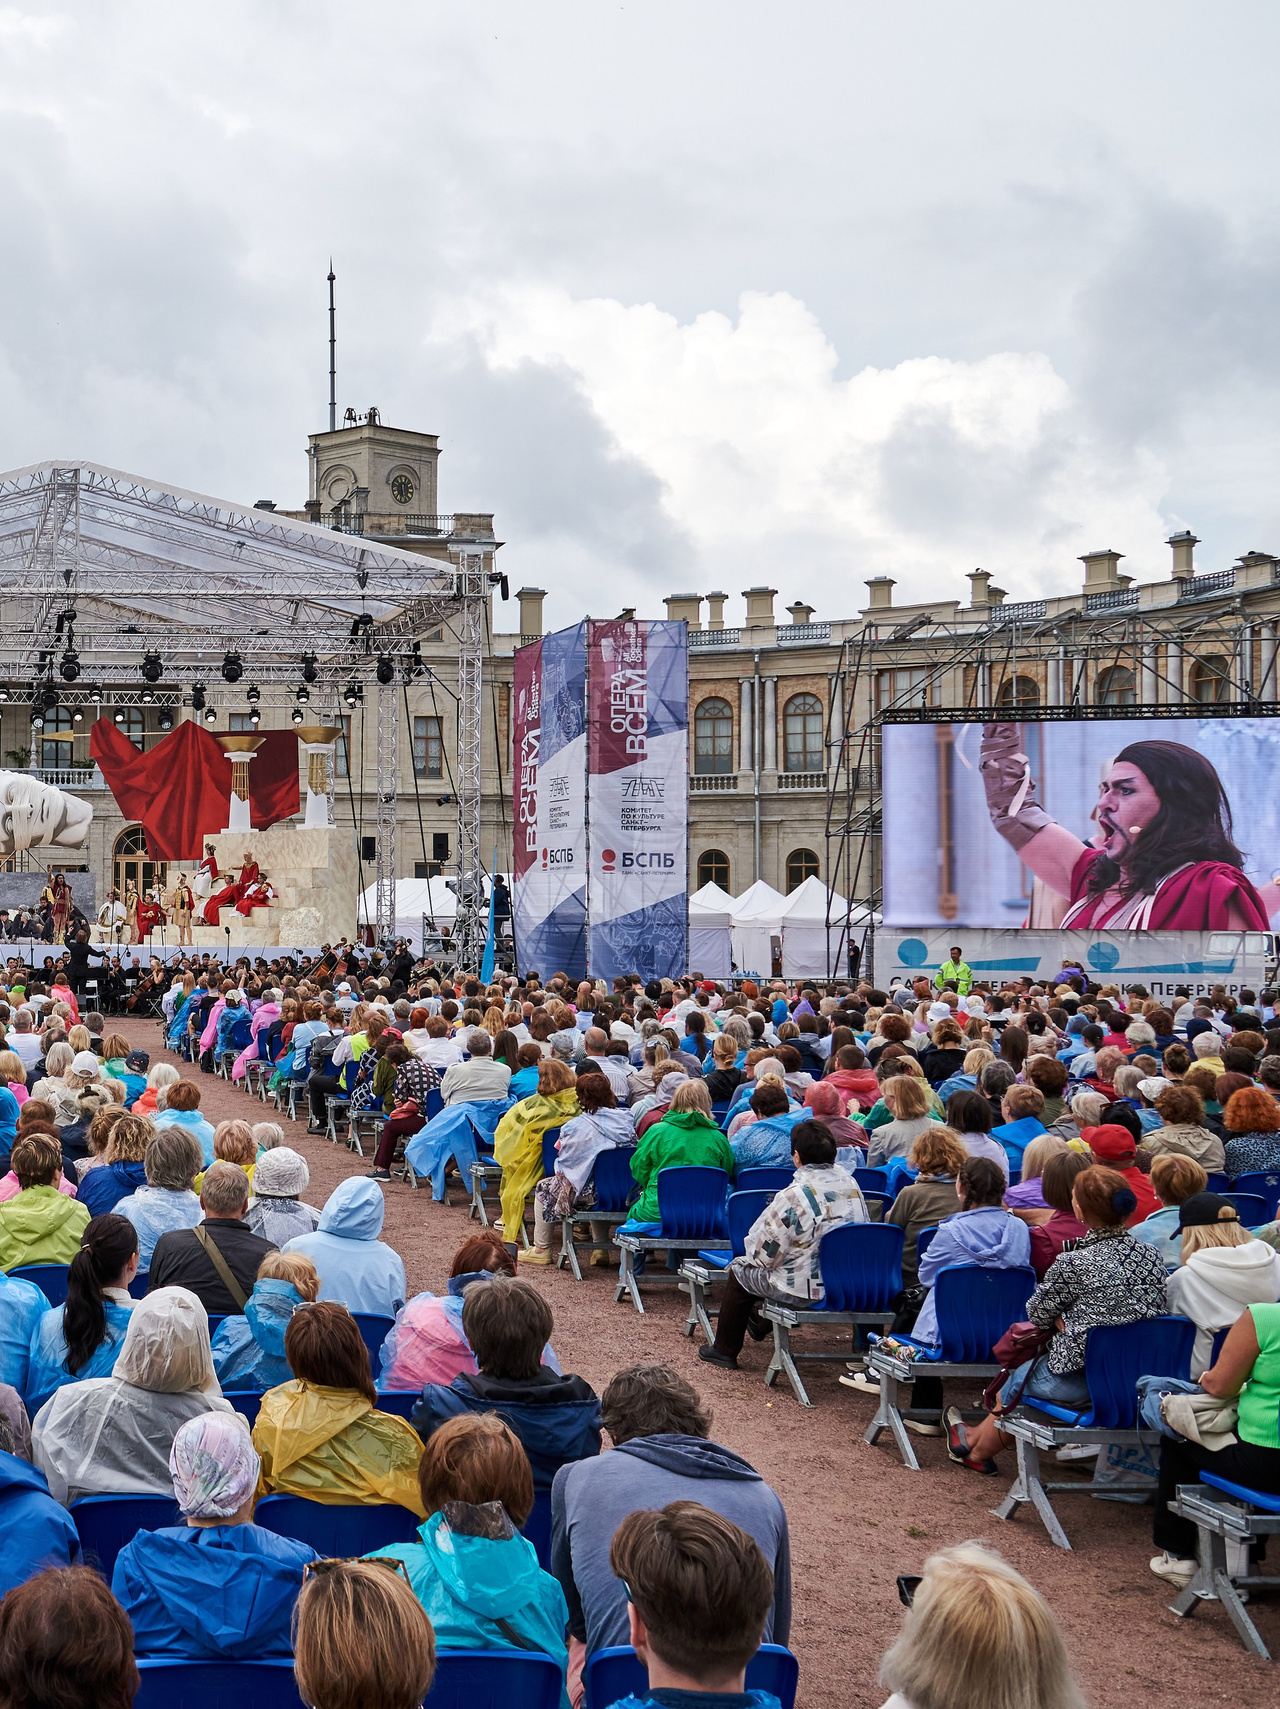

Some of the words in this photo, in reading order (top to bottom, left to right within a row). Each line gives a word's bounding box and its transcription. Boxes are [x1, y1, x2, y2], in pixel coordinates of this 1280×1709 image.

[623, 652, 631, 662] All
[625, 669, 648, 754] ВСЕМ
[526, 728, 541, 852] ВСЕМ
[550, 848, 573, 864] БСПБ
[622, 852, 674, 868] БСПБ
